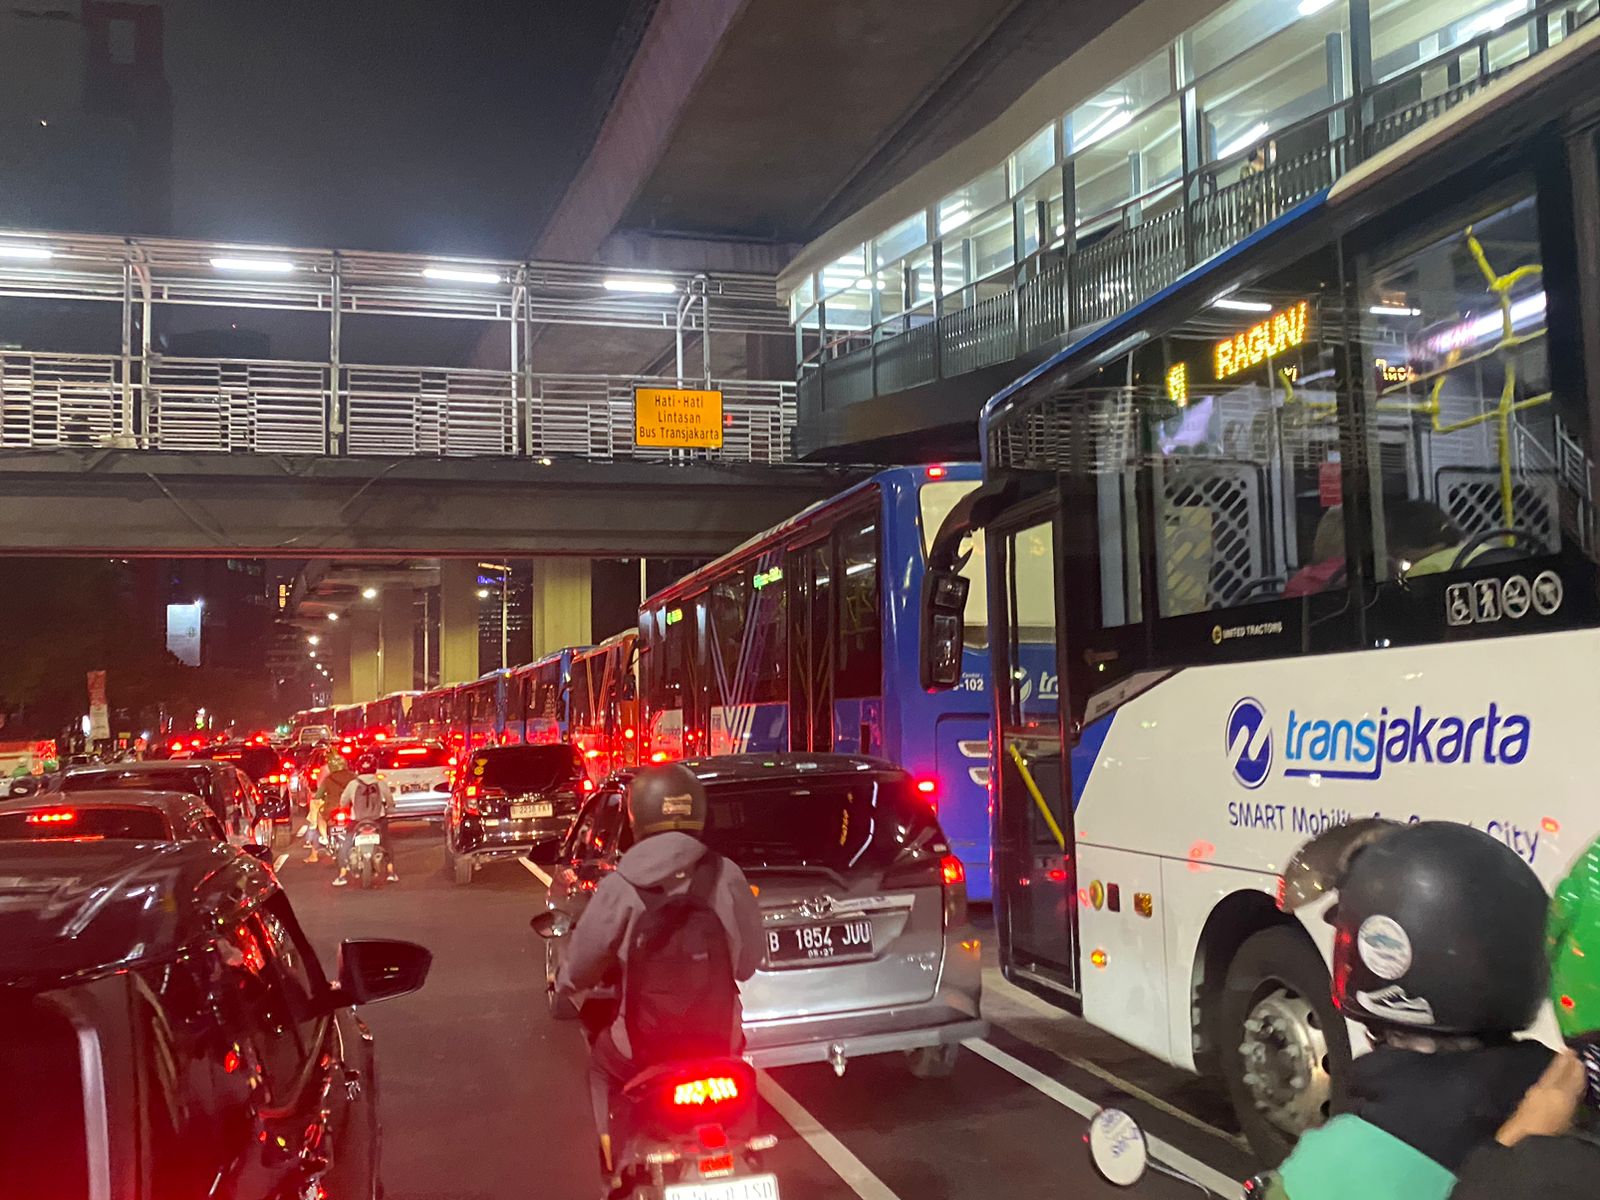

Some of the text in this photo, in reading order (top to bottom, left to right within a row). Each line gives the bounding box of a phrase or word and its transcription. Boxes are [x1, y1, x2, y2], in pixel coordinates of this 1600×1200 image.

[657, 411, 701, 424] Lintasan
[639, 426, 719, 442] Bus Transjakarta
[1284, 702, 1531, 780] transjakarta
[1228, 802, 1286, 831] SMART
[1292, 806, 1351, 835] Mobili
[769, 922, 871, 952] B 1854 JUU
